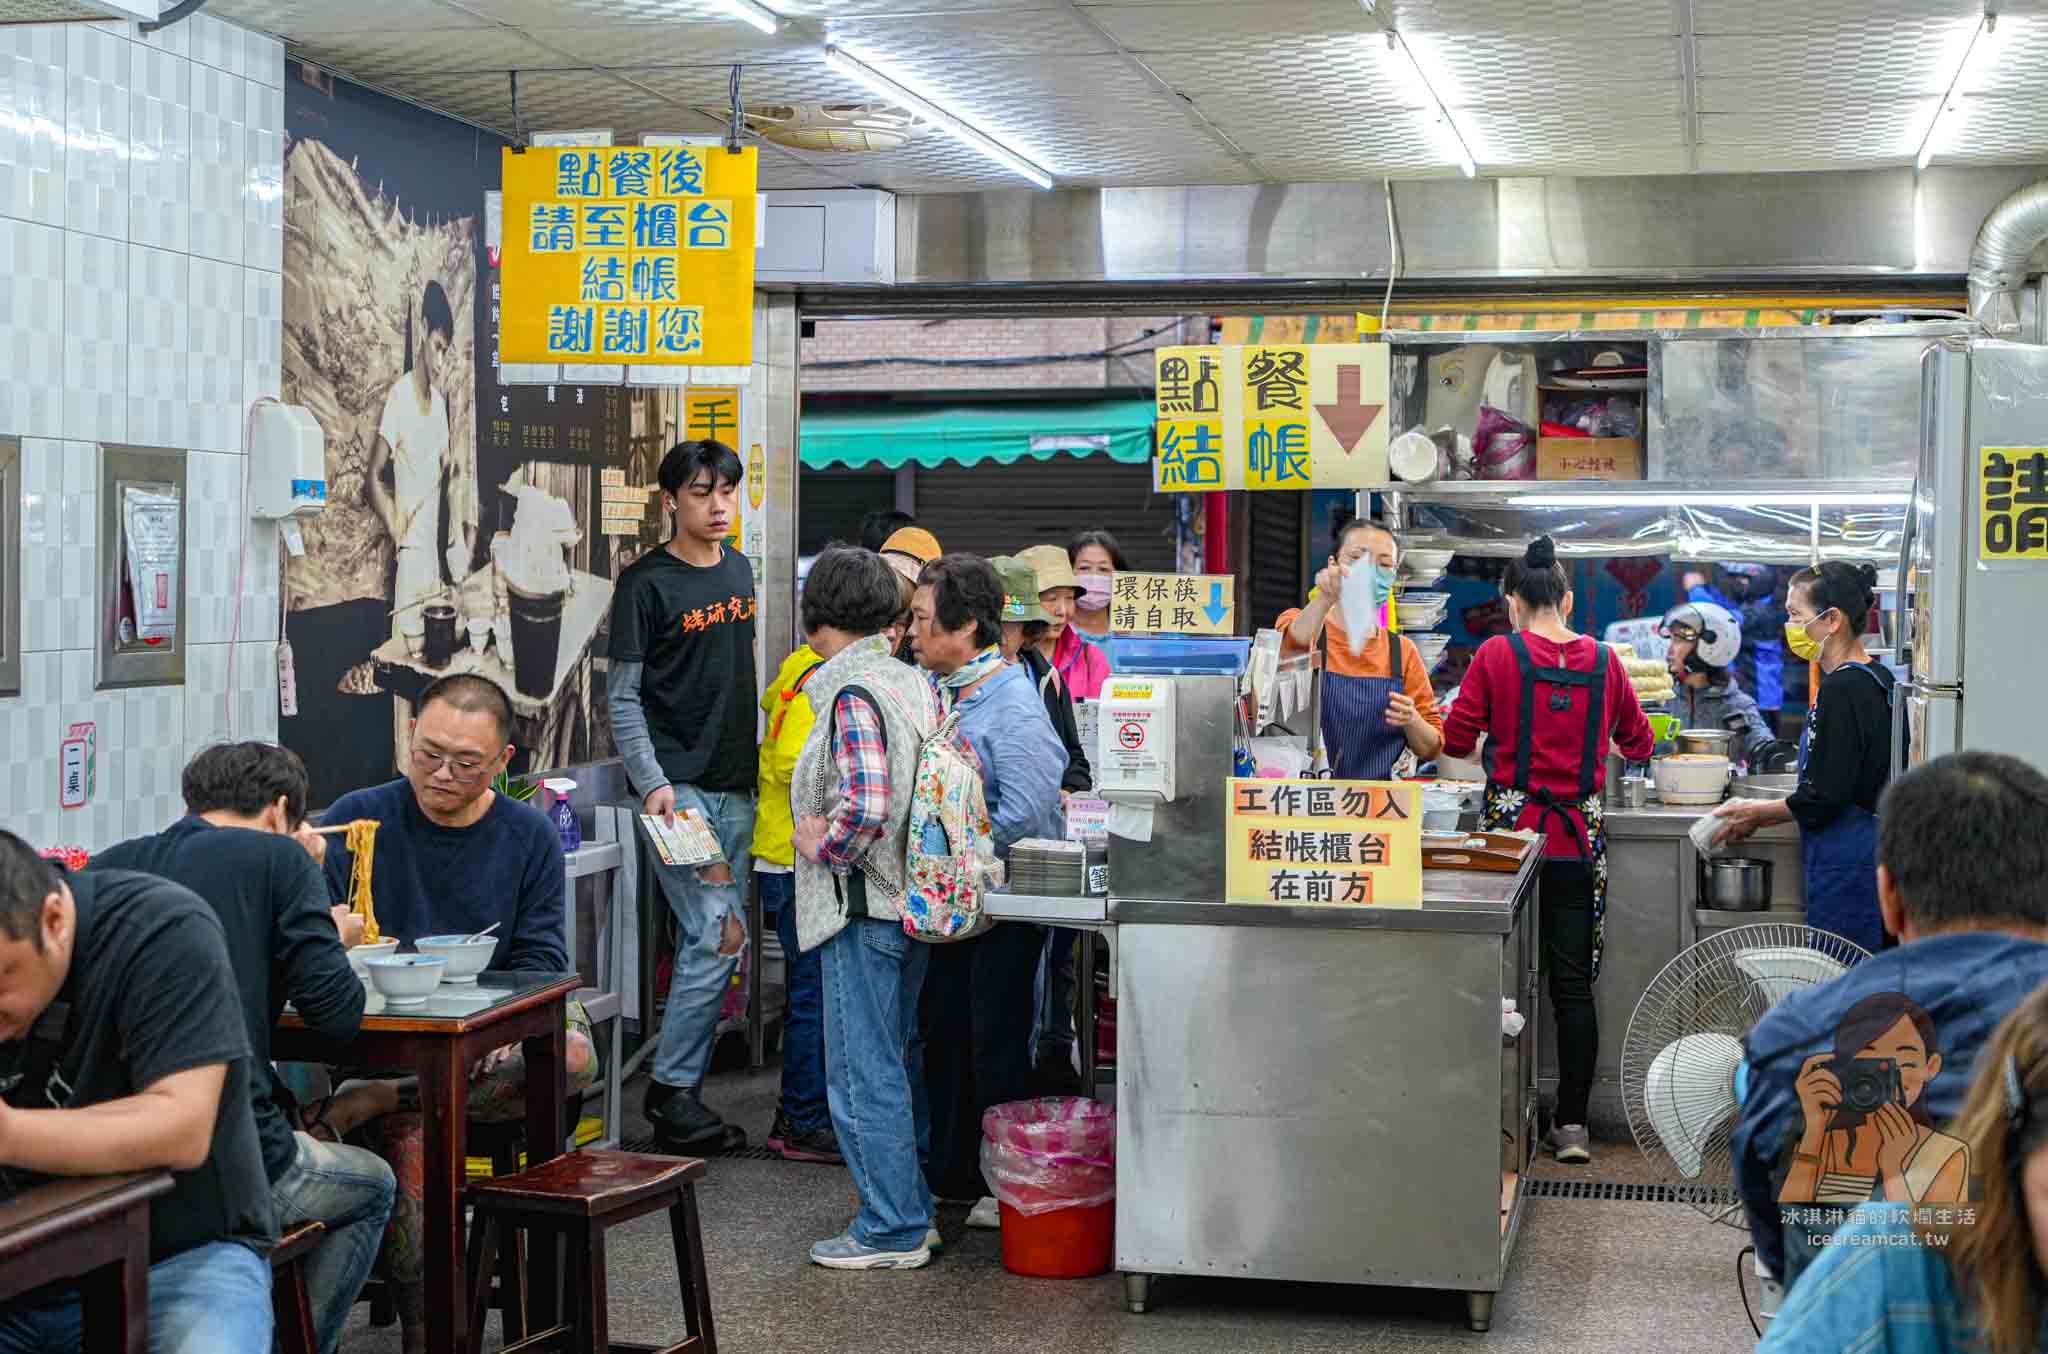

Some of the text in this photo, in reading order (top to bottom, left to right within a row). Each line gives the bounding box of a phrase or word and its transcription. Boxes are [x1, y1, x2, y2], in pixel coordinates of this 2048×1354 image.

[557, 150, 704, 196] 點餐後
[532, 202, 728, 250] 請至櫃台
[582, 256, 676, 301] 結帳
[548, 306, 701, 353] 謝謝您
[1160, 350, 1308, 413] 點餐
[1161, 422, 1310, 485] 結帳
[1113, 576, 1199, 602] 環保筷
[1113, 604, 1199, 631] 請自取
[1236, 785, 1409, 819] 工作區勿入
[1250, 829, 1385, 865] 結帳櫃台
[1269, 869, 1370, 903] 在前方
